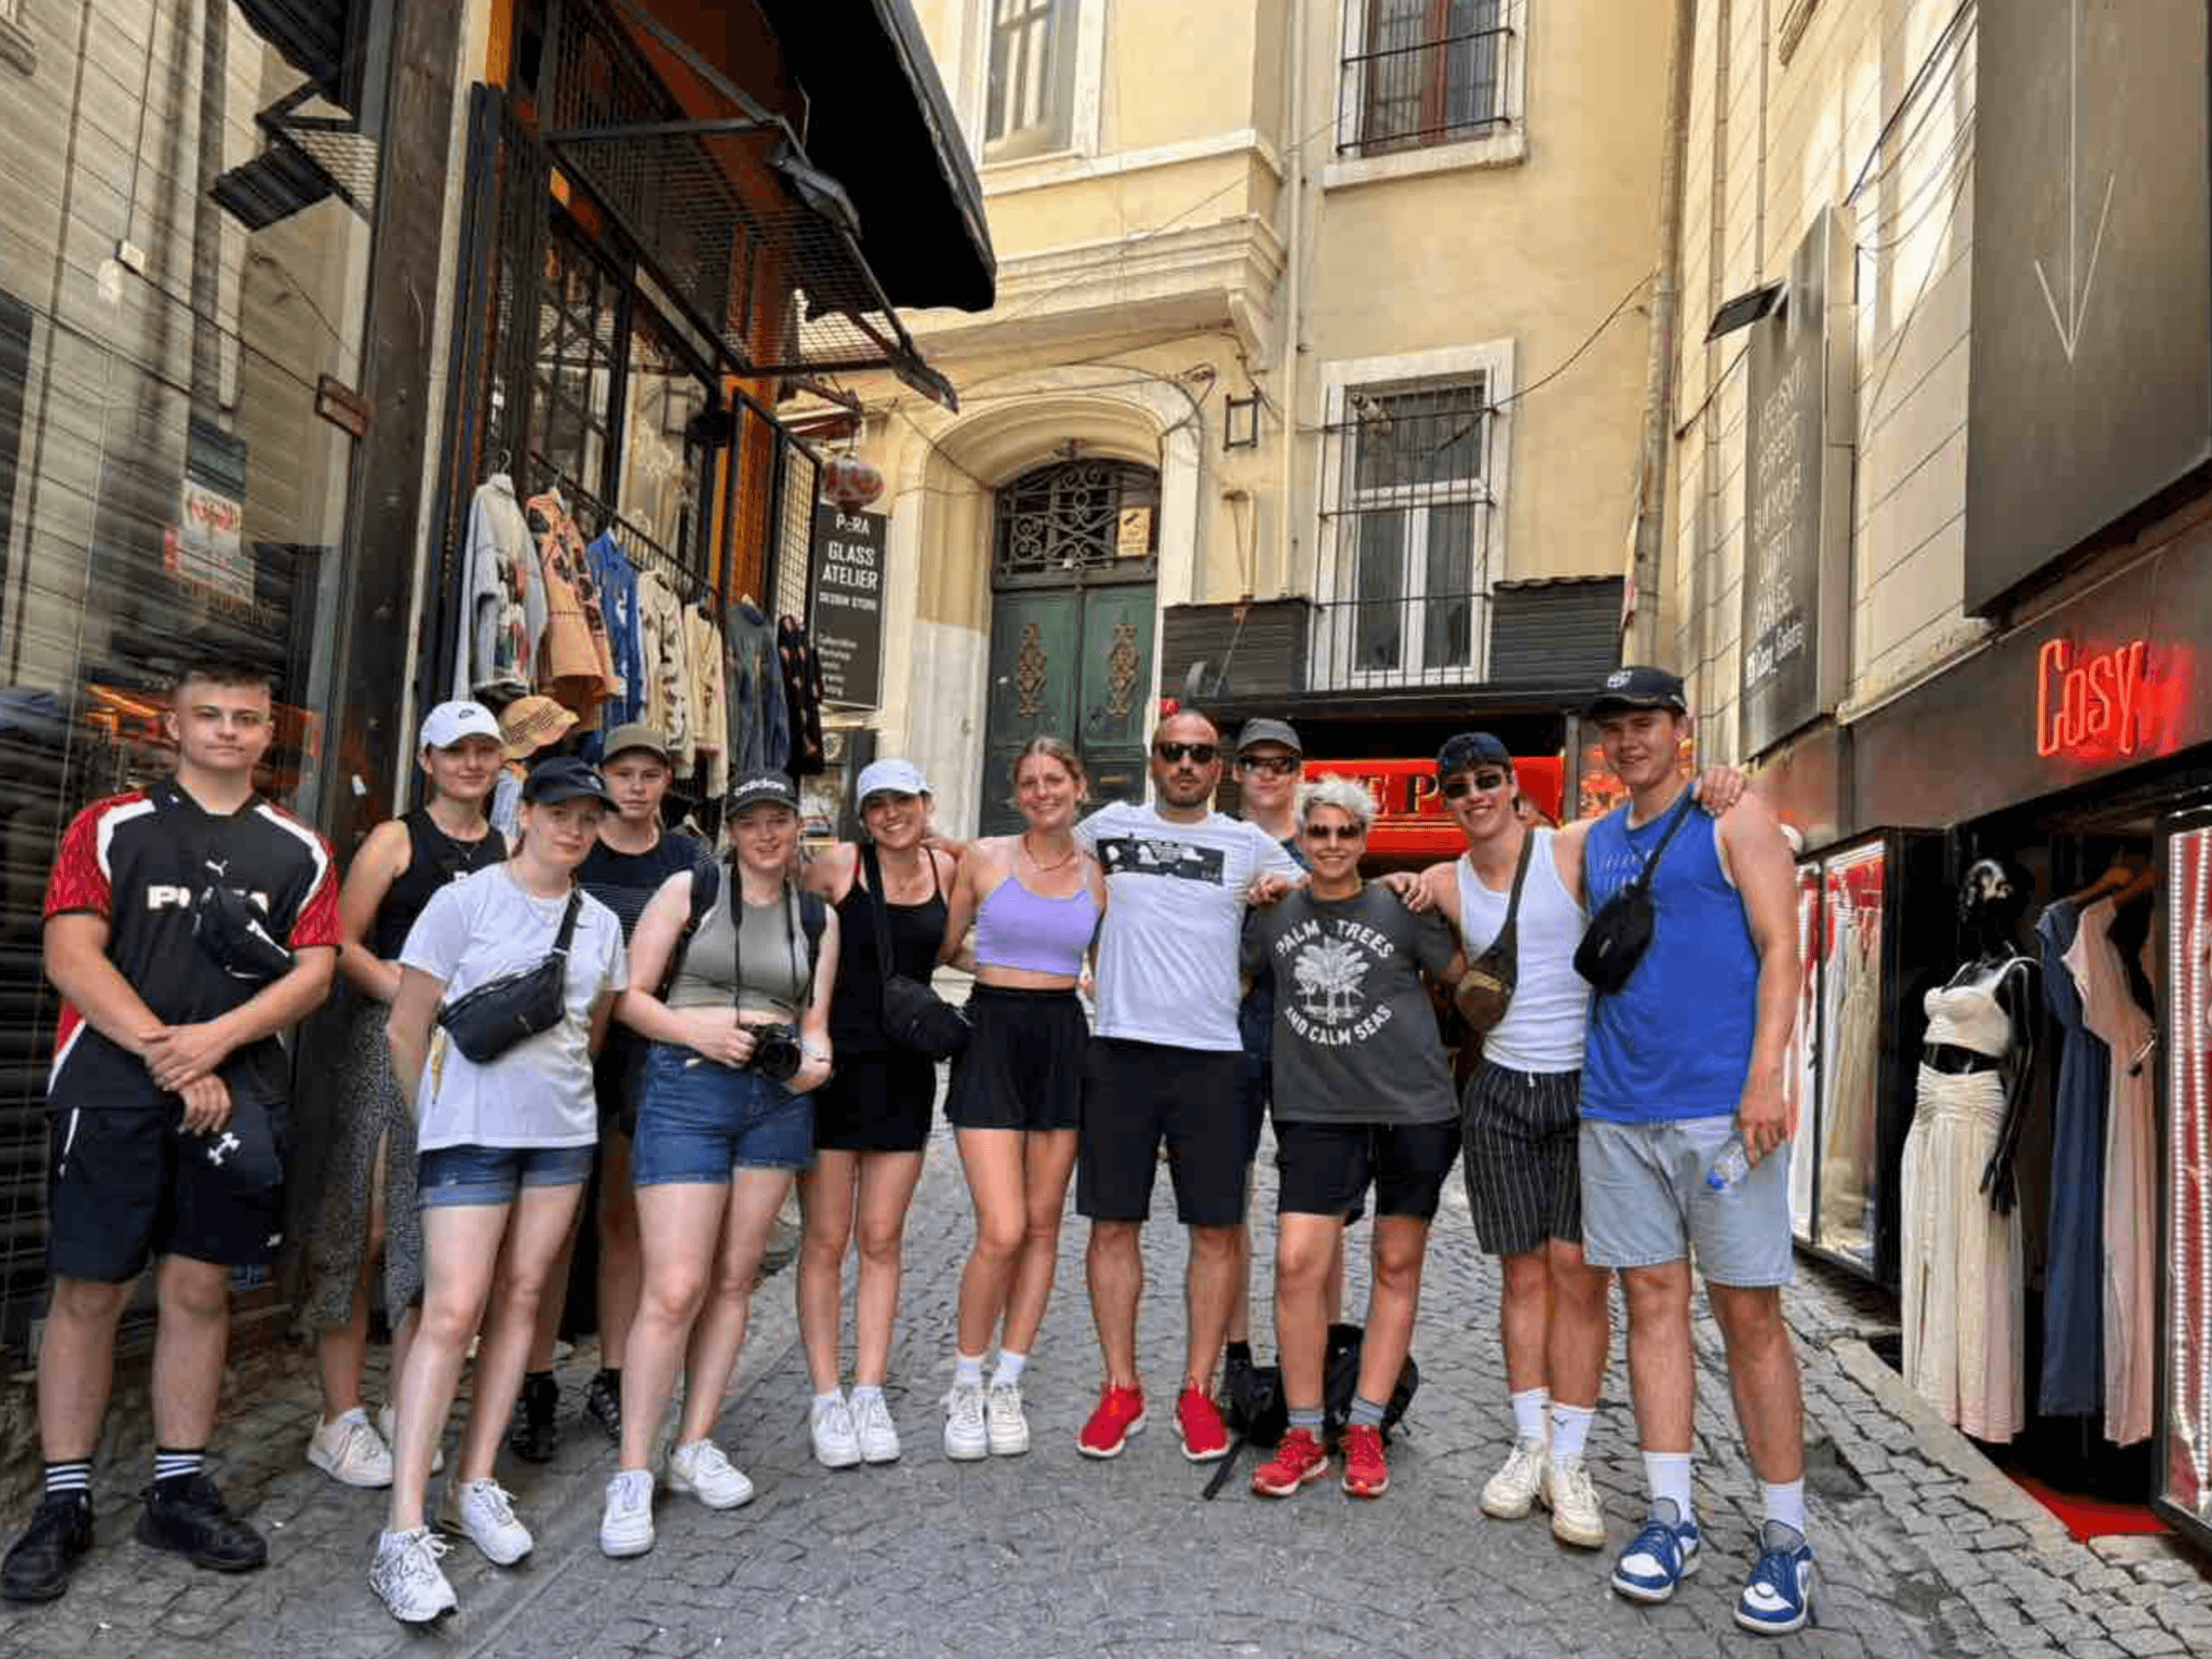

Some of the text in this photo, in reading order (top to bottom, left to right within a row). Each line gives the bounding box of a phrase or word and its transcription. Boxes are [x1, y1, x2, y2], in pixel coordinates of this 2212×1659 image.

[828, 540, 875, 566] GLASS
[822, 563, 879, 591] ATELIER
[1274, 918, 1395, 958] PALM TREES
[1284, 1003, 1393, 1046] AND CALM SEAS
